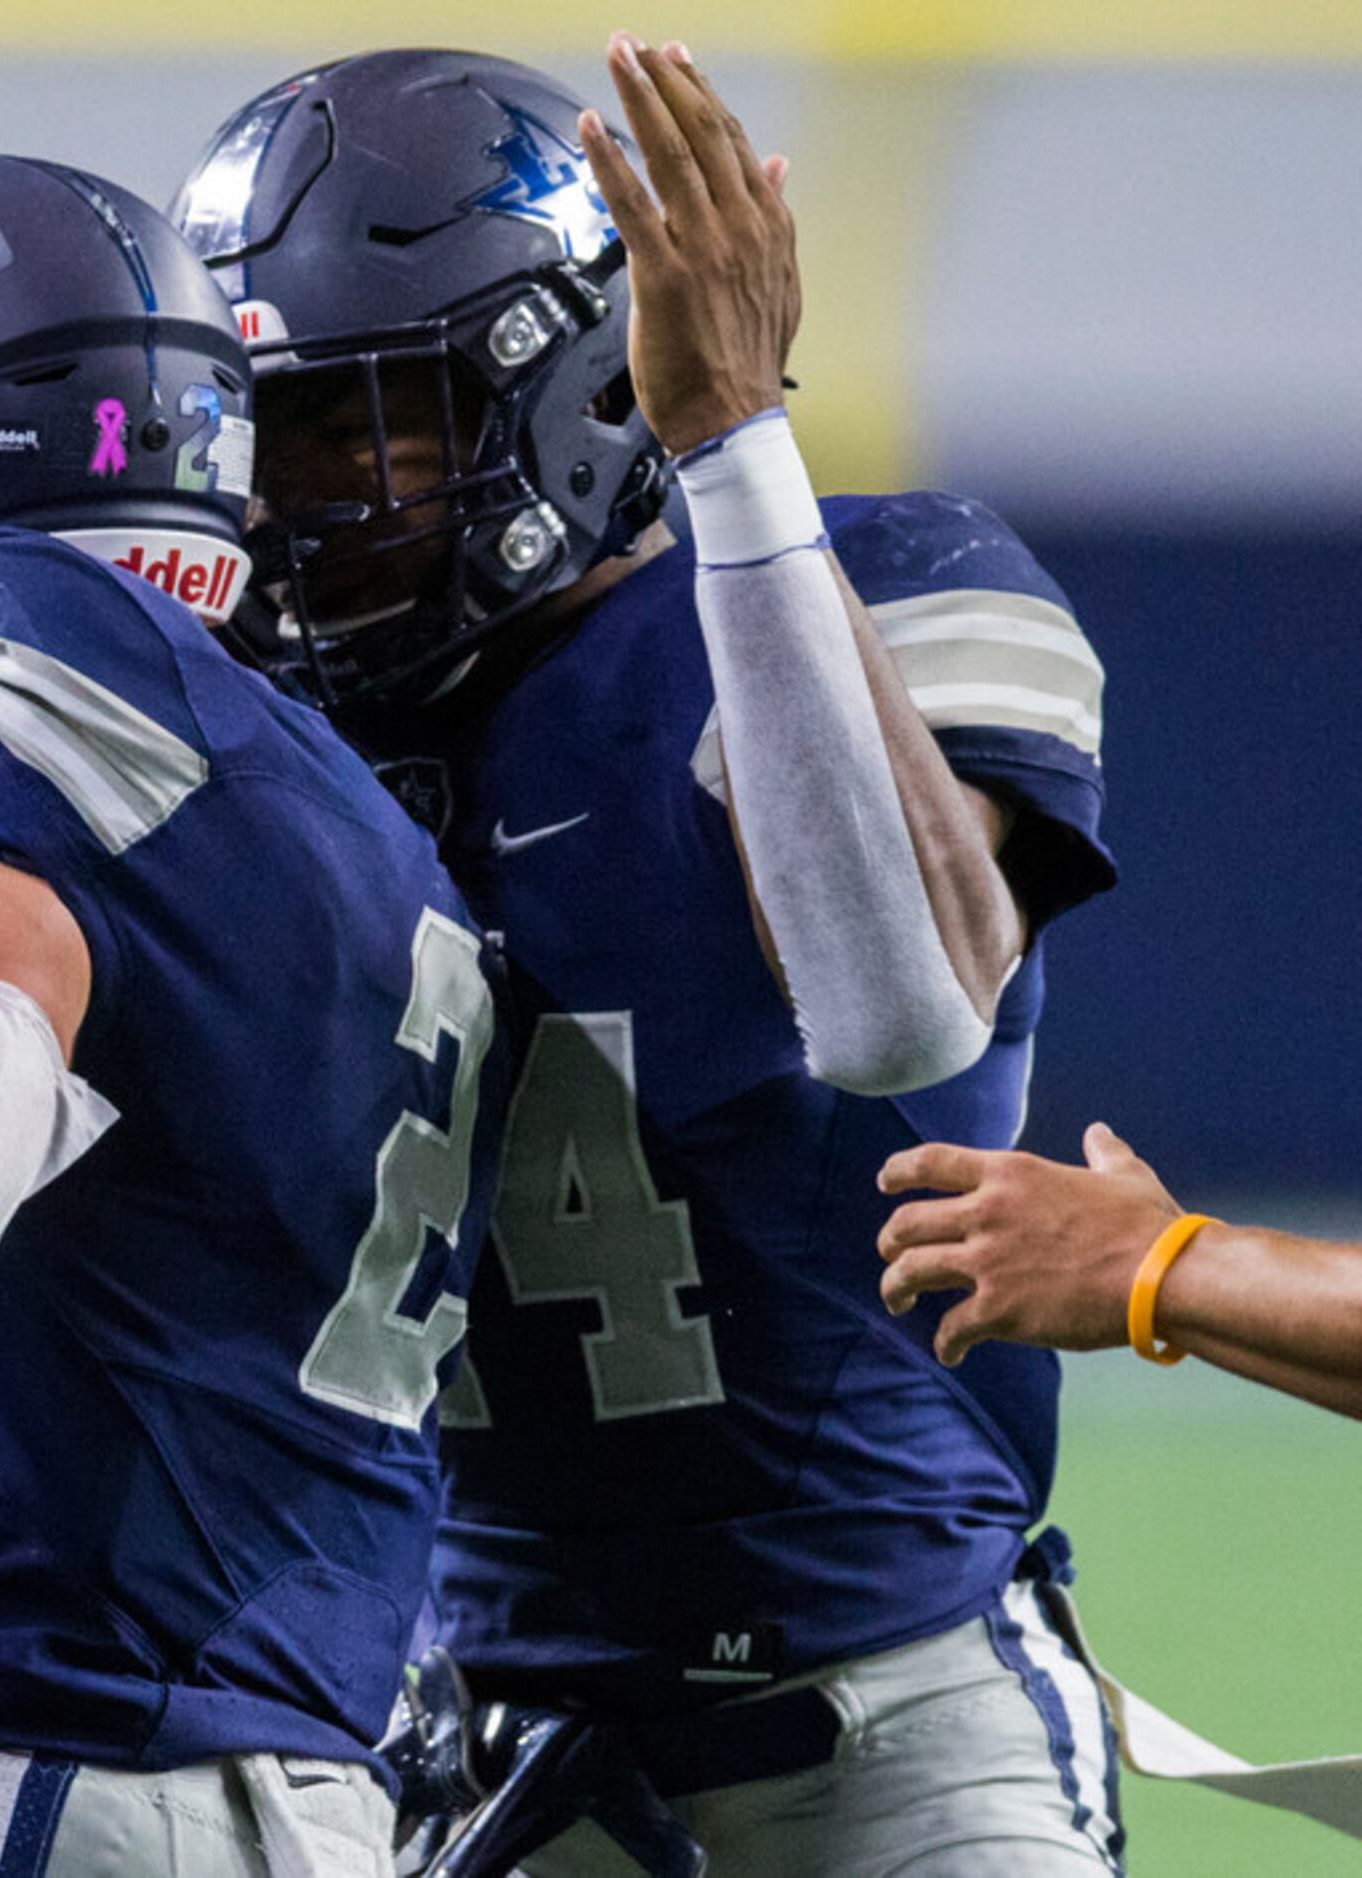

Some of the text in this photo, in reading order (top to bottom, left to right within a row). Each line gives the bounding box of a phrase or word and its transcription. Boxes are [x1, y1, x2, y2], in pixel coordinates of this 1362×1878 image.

[174, 383, 221, 493] 2
[299, 904, 495, 1433] 2
[438, 1009, 726, 1427] 4
[711, 1632, 751, 1662] M
